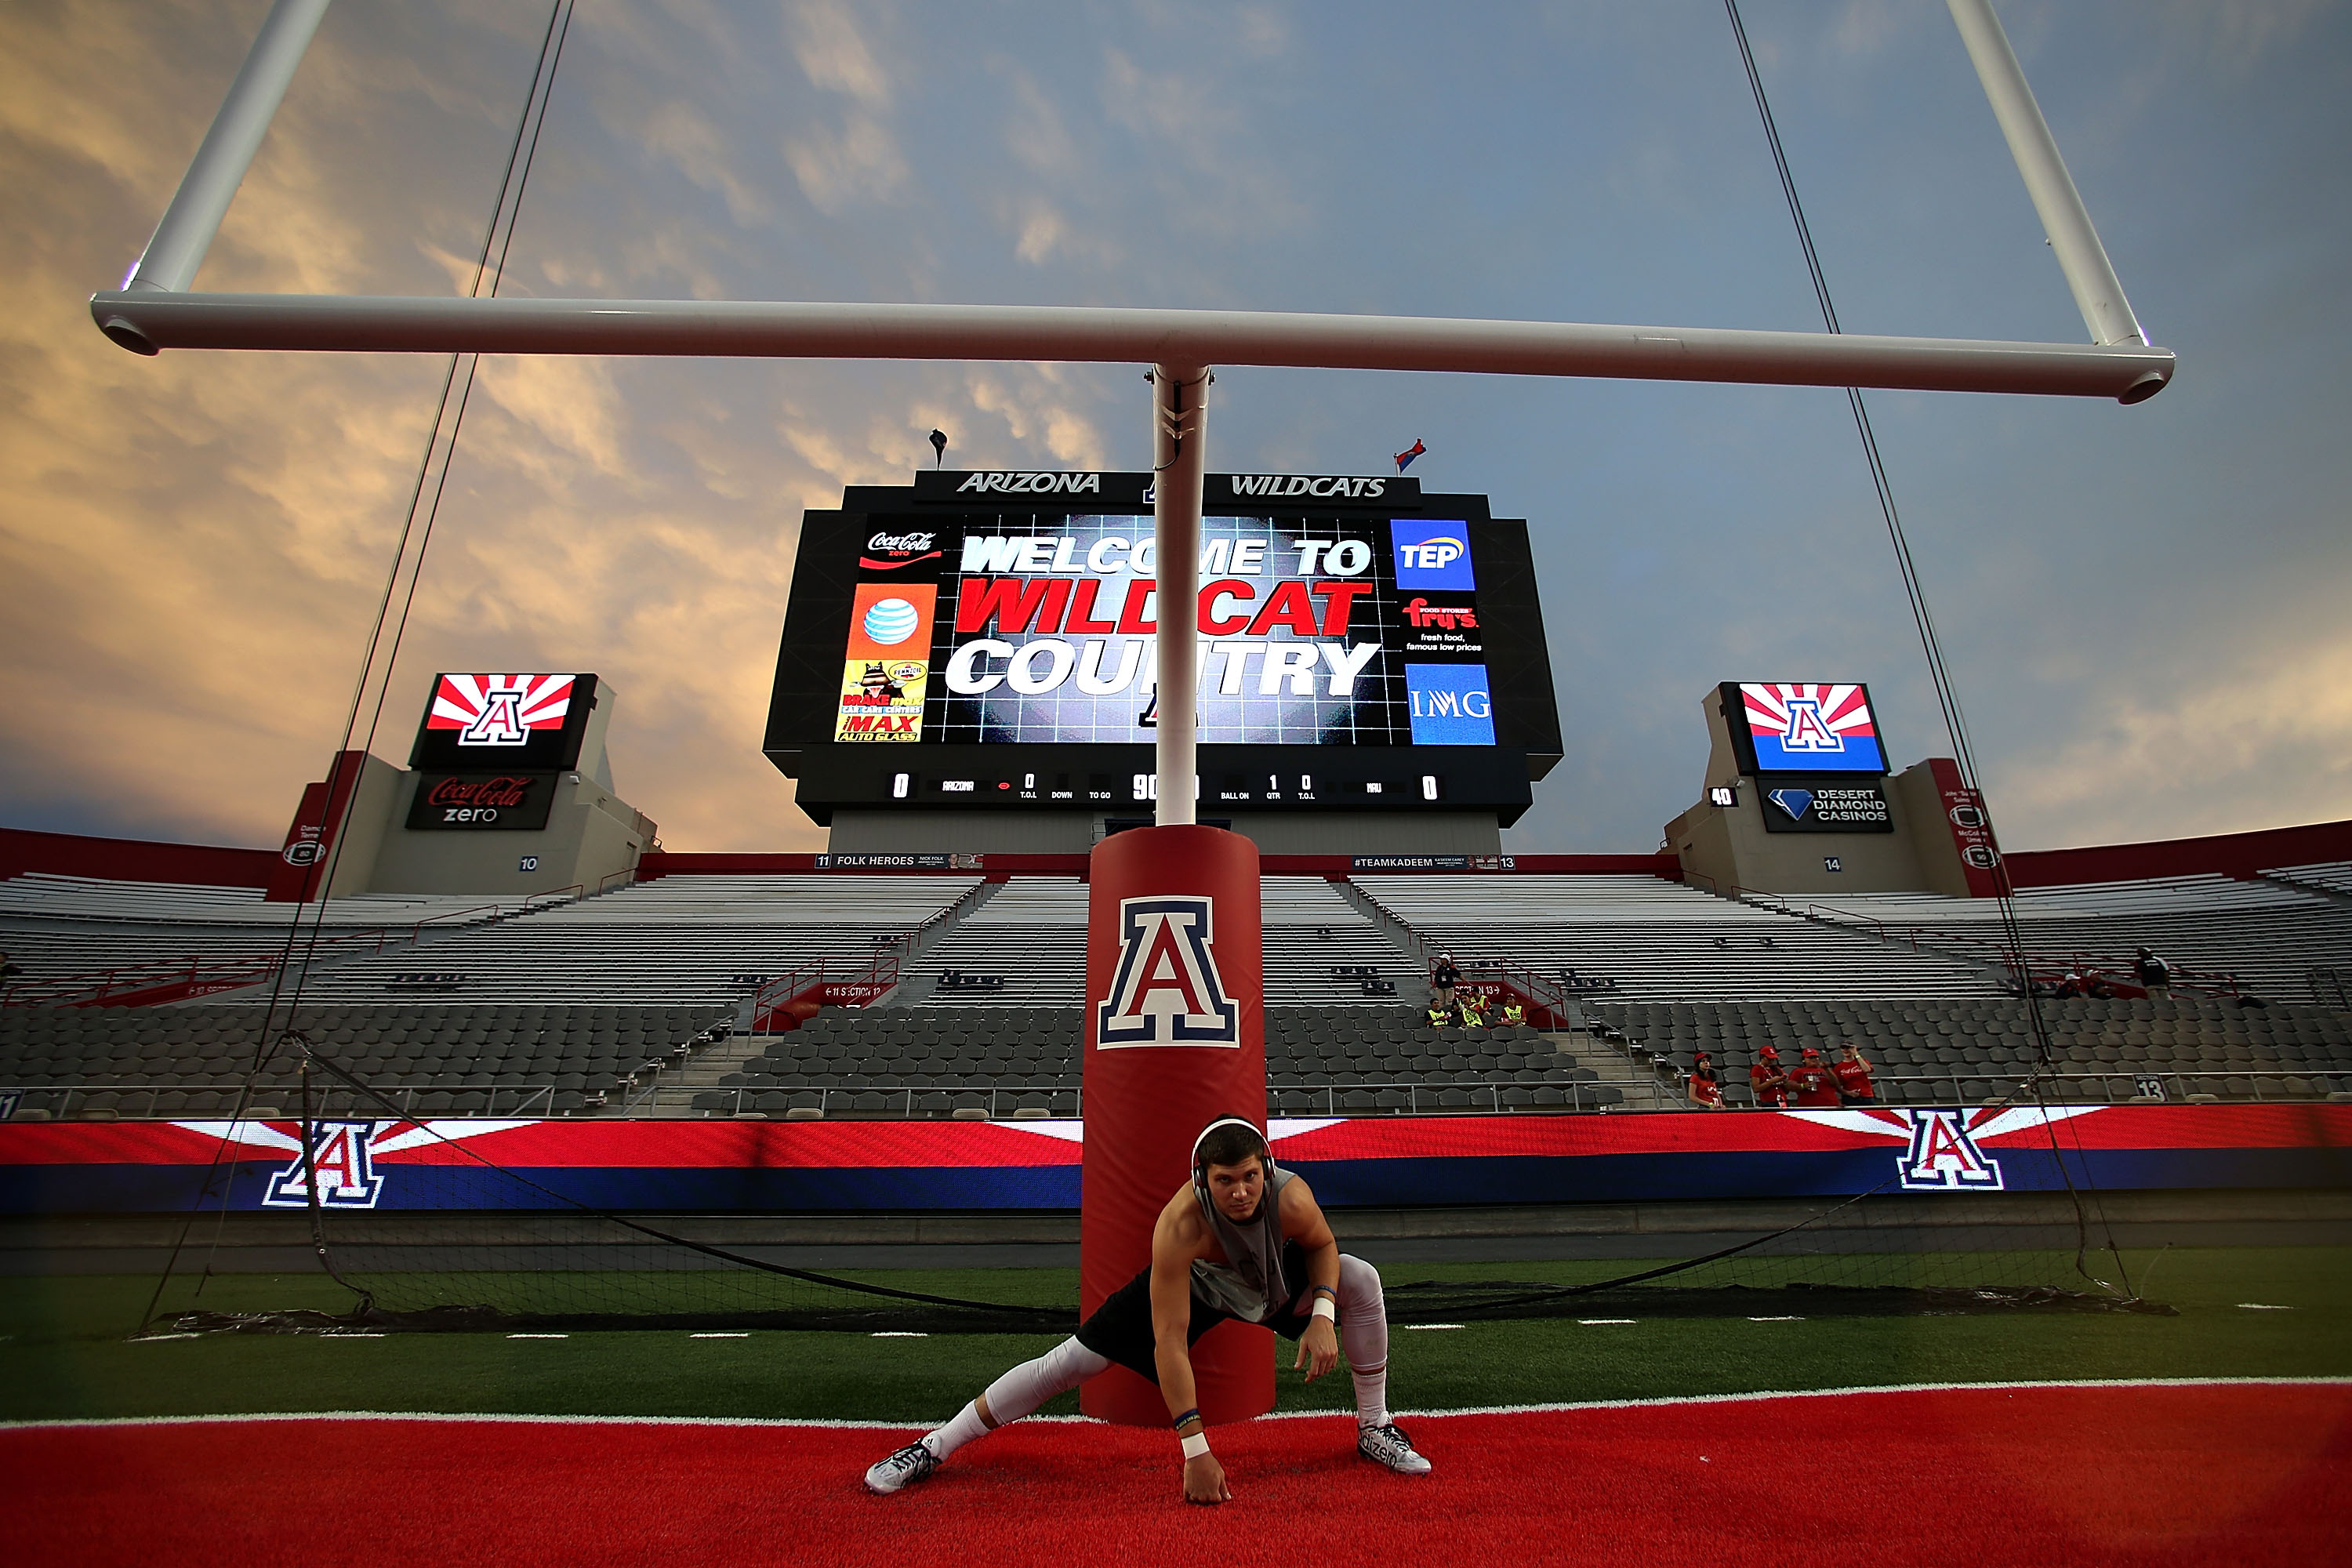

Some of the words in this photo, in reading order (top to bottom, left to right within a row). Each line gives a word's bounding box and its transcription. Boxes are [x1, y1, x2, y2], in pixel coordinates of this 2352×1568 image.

[956, 473, 1099, 493] ARIZONA
[1232, 476, 1386, 497] WILDCATS
[868, 532, 936, 550] Coca-Cola
[1291, 539, 1371, 576] TO
[1400, 545, 1458, 568] TEP
[955, 578, 1373, 636] WILDCAT
[843, 695, 890, 706] BRAKE
[890, 697, 924, 706] max
[1410, 690, 1490, 717] IMG
[457, 688, 531, 746] A
[847, 716, 919, 731] MAX
[1779, 695, 1846, 753] A
[839, 732, 873, 741] AUTO
[875, 732, 916, 741] GLASS
[894, 774, 909, 798] 0
[942, 781, 974, 792] ARIZONA
[1025, 774, 1035, 788] 0
[1270, 775, 1276, 789] 1
[1301, 775, 1311, 789] 0
[1422, 775, 1437, 800] 0
[427, 777, 534, 806] Coca-Cola
[1711, 788, 1732, 805] 40
[1817, 789, 1875, 799] DESERT
[1813, 800, 1886, 810] DIAMOND
[443, 808, 497, 822] zero
[1818, 811, 1887, 821] CASINOS
[521, 858, 537, 869] 10
[818, 855, 829, 866] 11
[837, 856, 866, 865] FOLK
[869, 856, 914, 866] HEROES
[1501, 857, 1514, 867] 13
[1825, 859, 1840, 870] 14
[1097, 895, 1240, 1051] A
[1486, 985, 1494, 994] 13
[2138, 1080, 2166, 1102] 13
[1896, 1107, 2005, 1191] A
[261, 1120, 383, 1209] A
